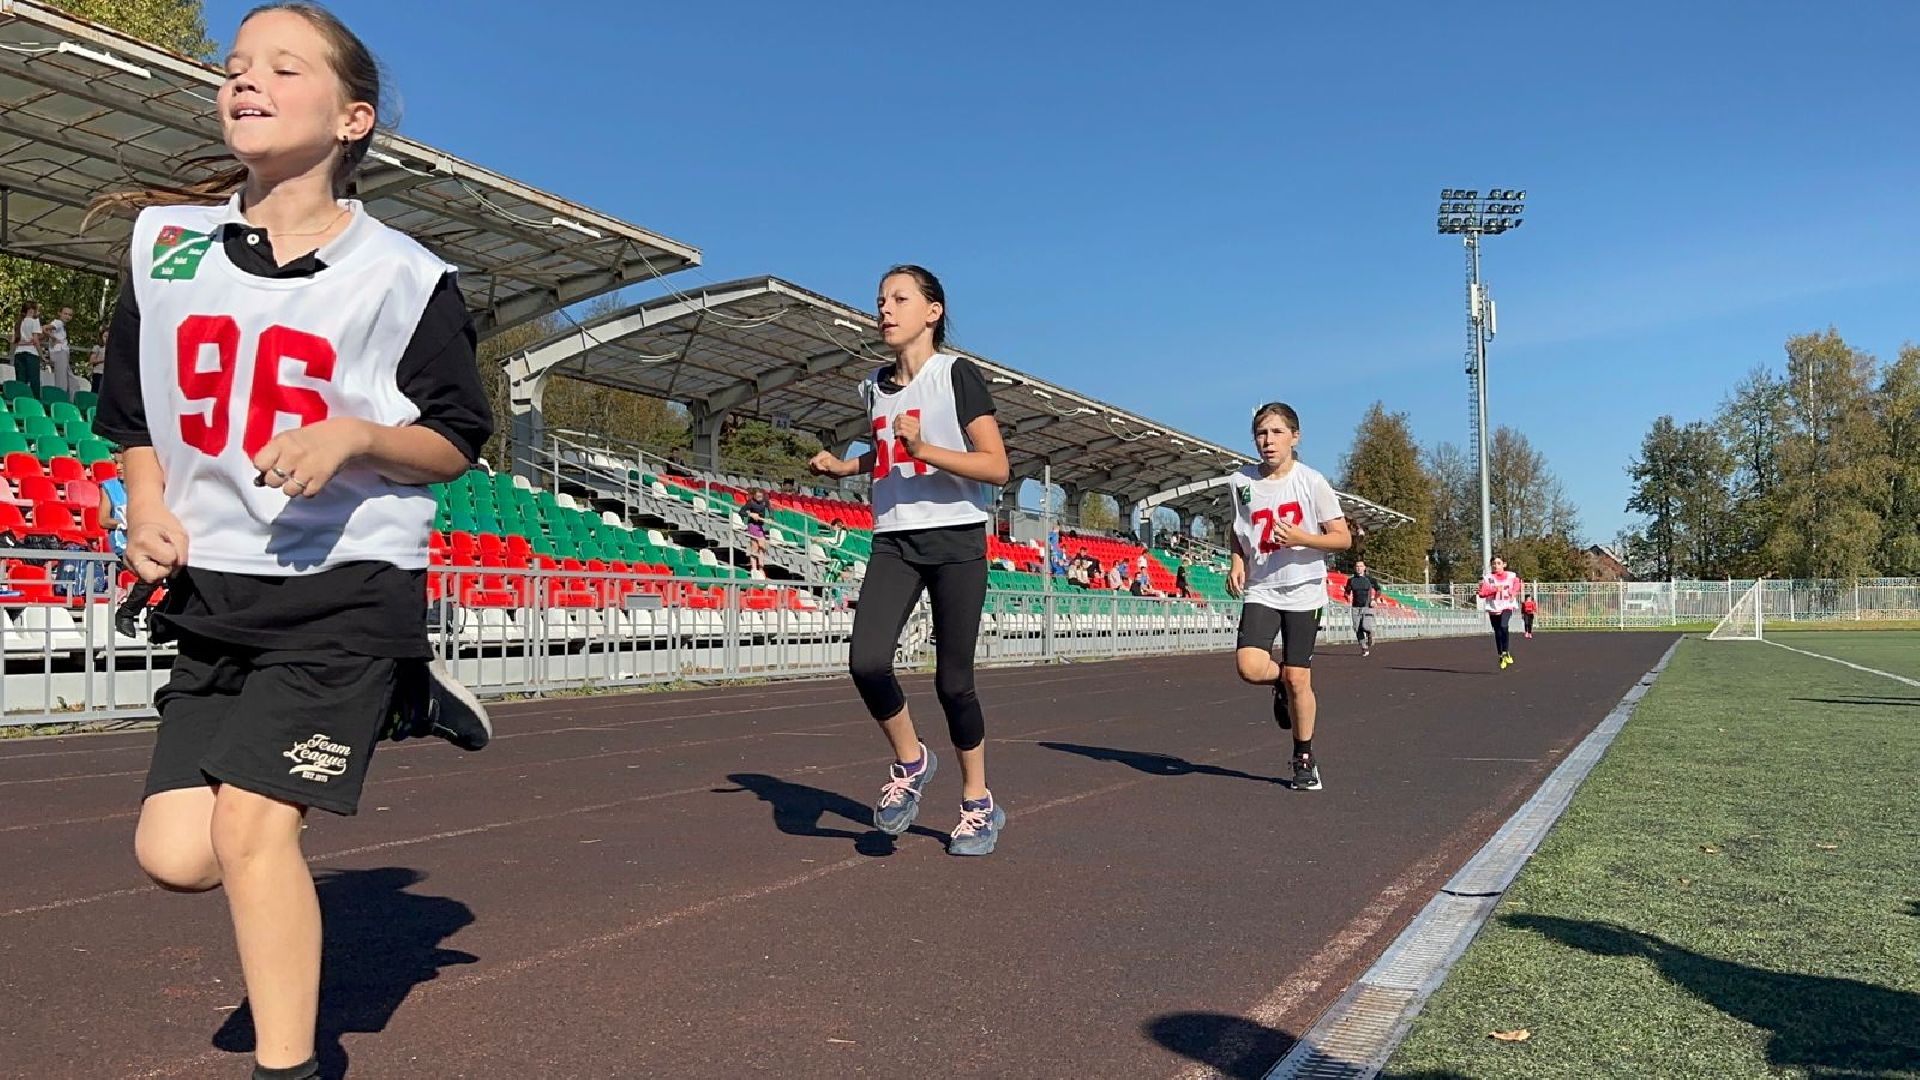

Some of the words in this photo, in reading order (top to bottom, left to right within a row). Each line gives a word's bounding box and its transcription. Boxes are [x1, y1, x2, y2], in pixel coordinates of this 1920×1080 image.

[177, 314, 337, 463] 96
[283, 741, 347, 767] League
[307, 733, 351, 756] Team
